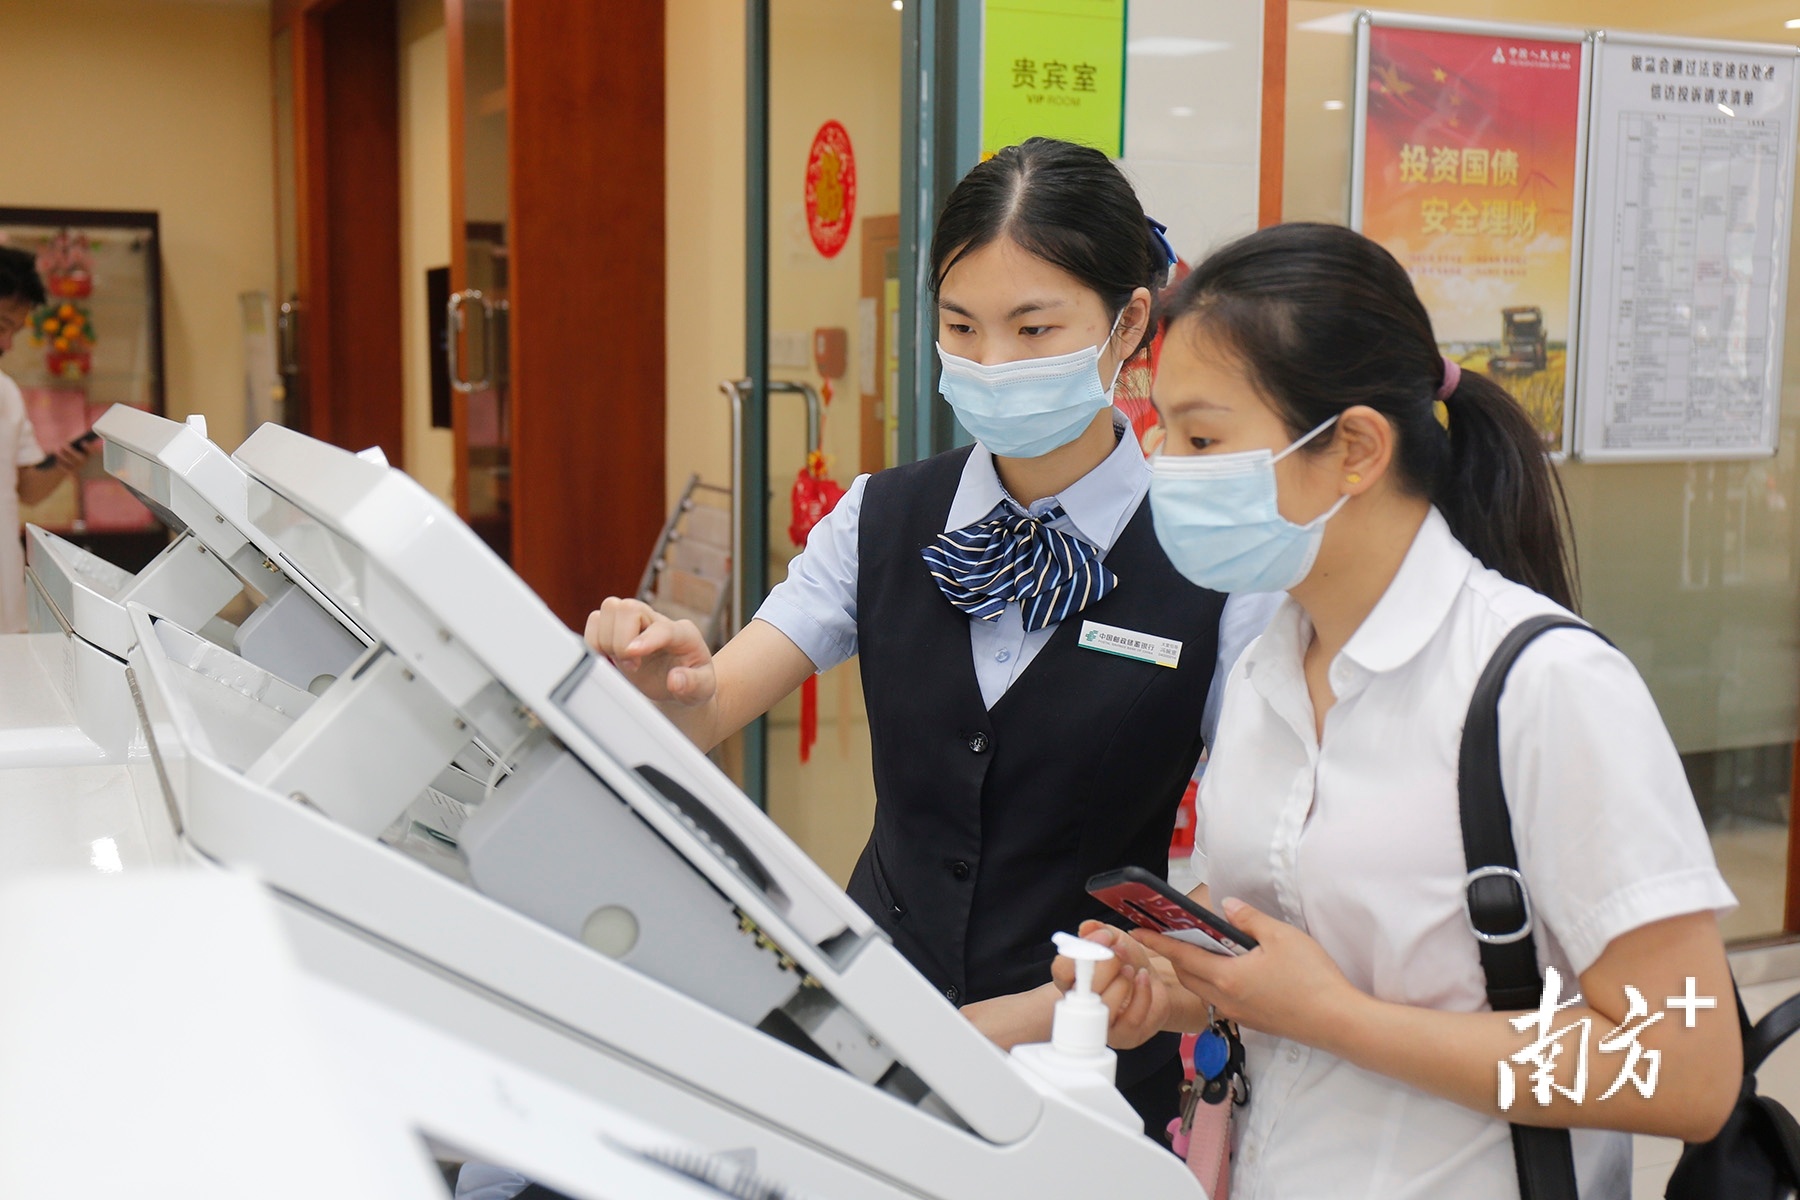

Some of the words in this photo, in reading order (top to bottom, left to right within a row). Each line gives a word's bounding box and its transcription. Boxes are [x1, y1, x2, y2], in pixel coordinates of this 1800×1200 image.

[1508, 47, 1571, 62] 中国人民银行
[1012, 58, 1097, 92] 贵宾室
[1026, 94, 1044, 104] VIP
[1047, 95, 1081, 107] ROOM
[1651, 84, 1754, 105] 信访投诉请求清单
[1400, 144, 1519, 187] 投资国债
[1422, 197, 1537, 237] 安全理财
[1099, 633, 1155, 651] 中国邮政储蓄银行
